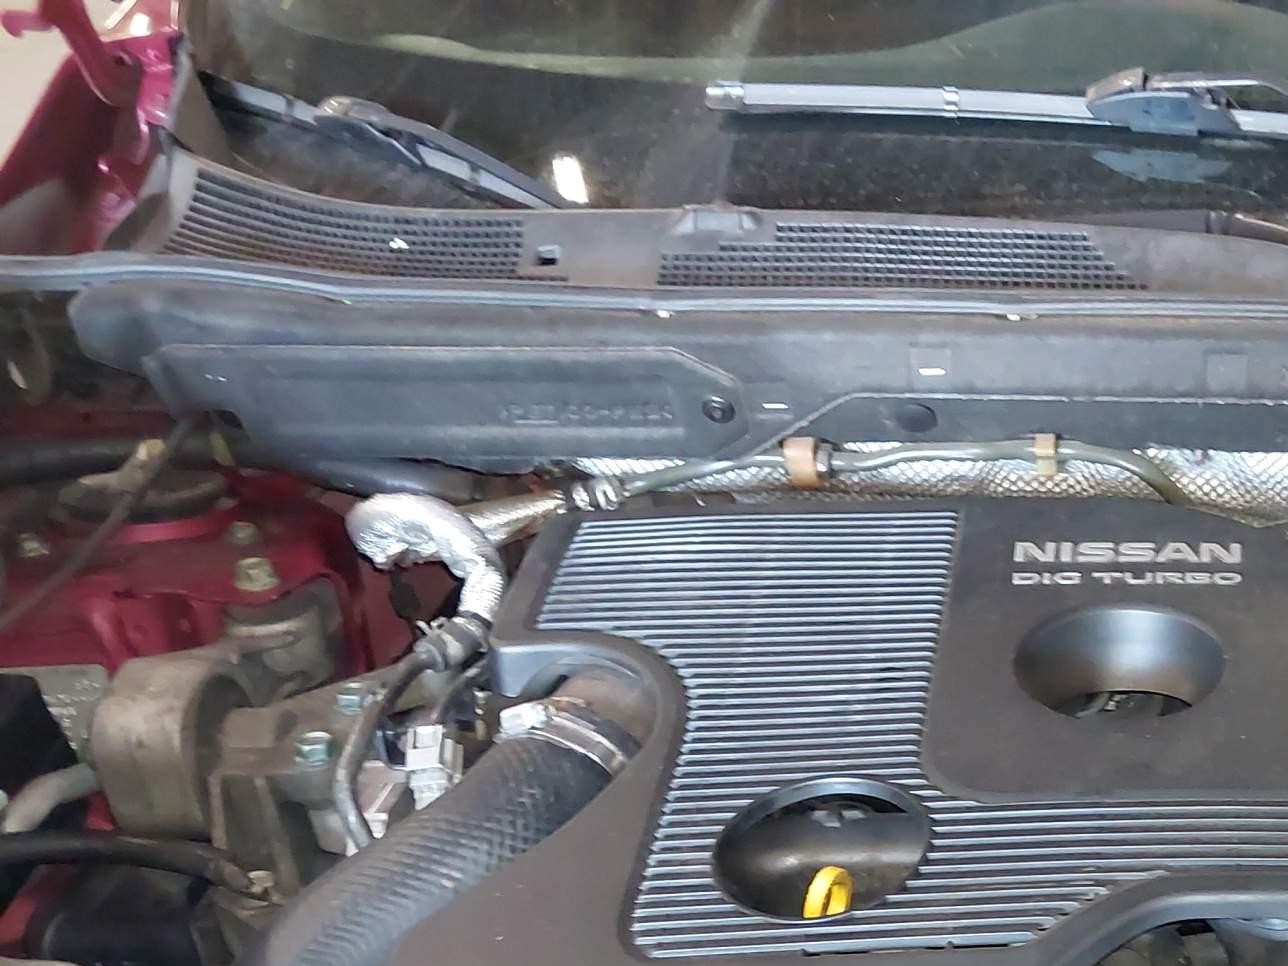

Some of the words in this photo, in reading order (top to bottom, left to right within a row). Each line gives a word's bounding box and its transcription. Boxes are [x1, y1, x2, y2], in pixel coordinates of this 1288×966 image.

[1013, 541, 1242, 564] NISSAN
[1011, 572, 1082, 585] DIG
[1091, 572, 1243, 585] TURBO
